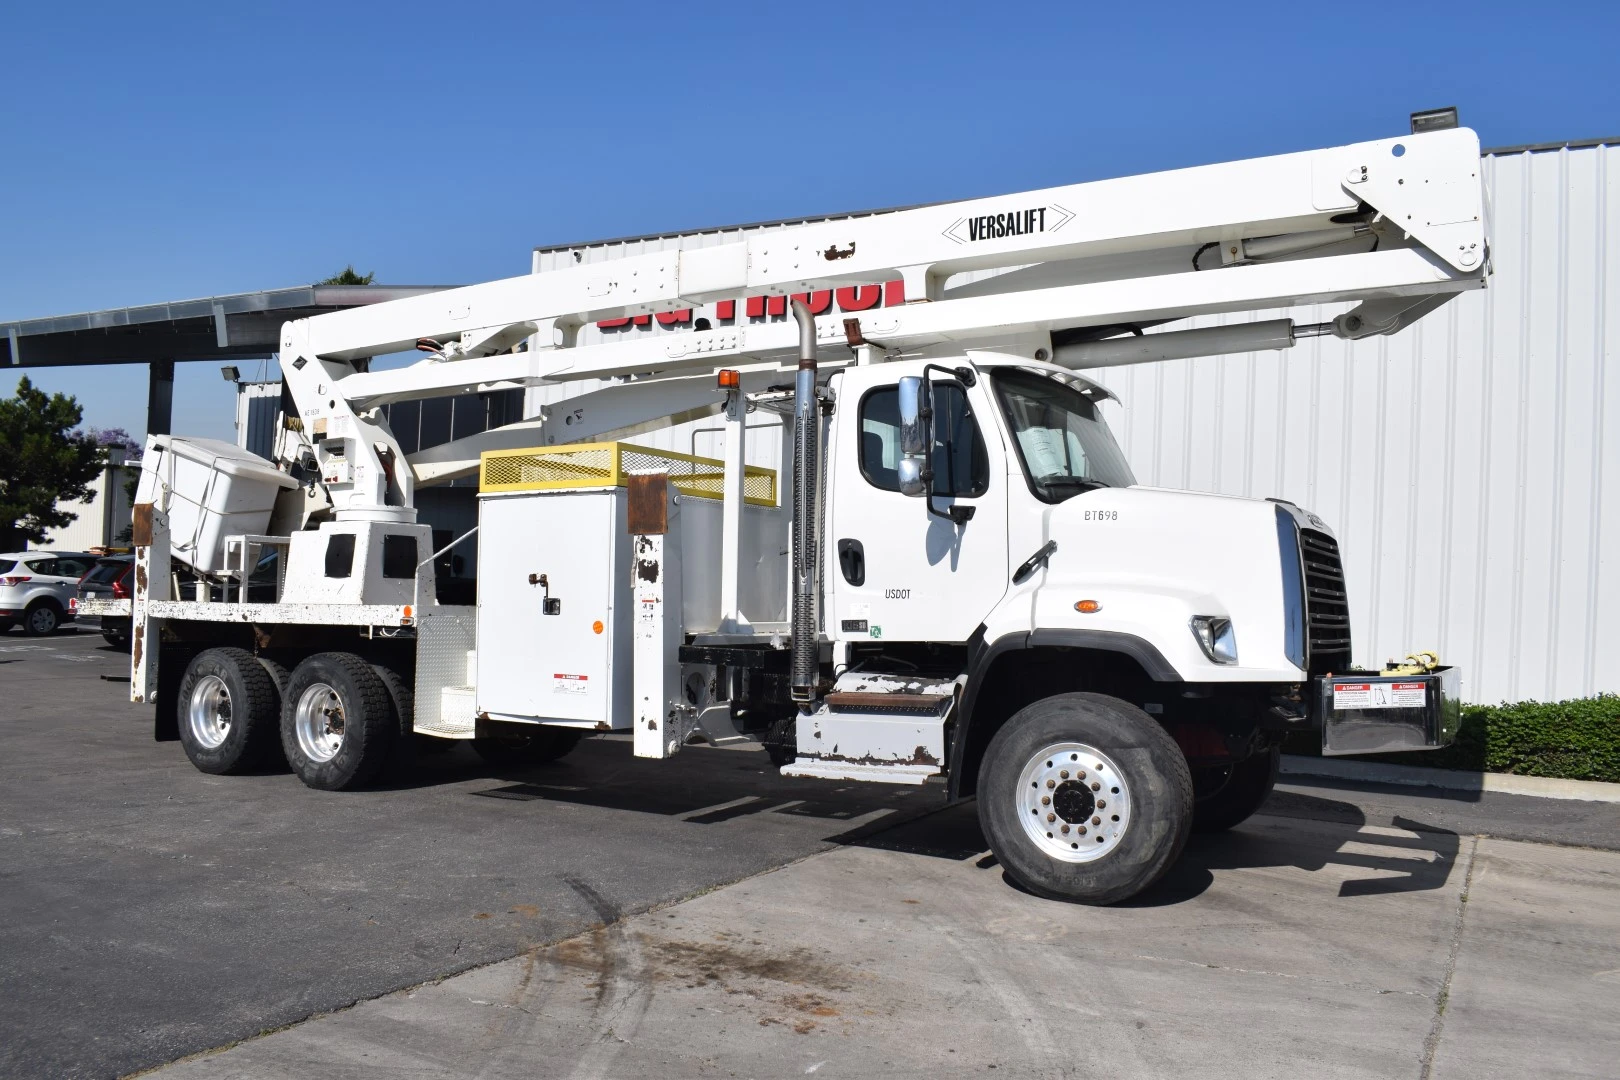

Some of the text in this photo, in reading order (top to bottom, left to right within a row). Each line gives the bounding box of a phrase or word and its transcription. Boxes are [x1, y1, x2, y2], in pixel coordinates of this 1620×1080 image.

[968, 207, 1047, 242] VERSALIFT
[1084, 510, 1118, 521] BT698
[885, 589, 911, 599] USDOT
